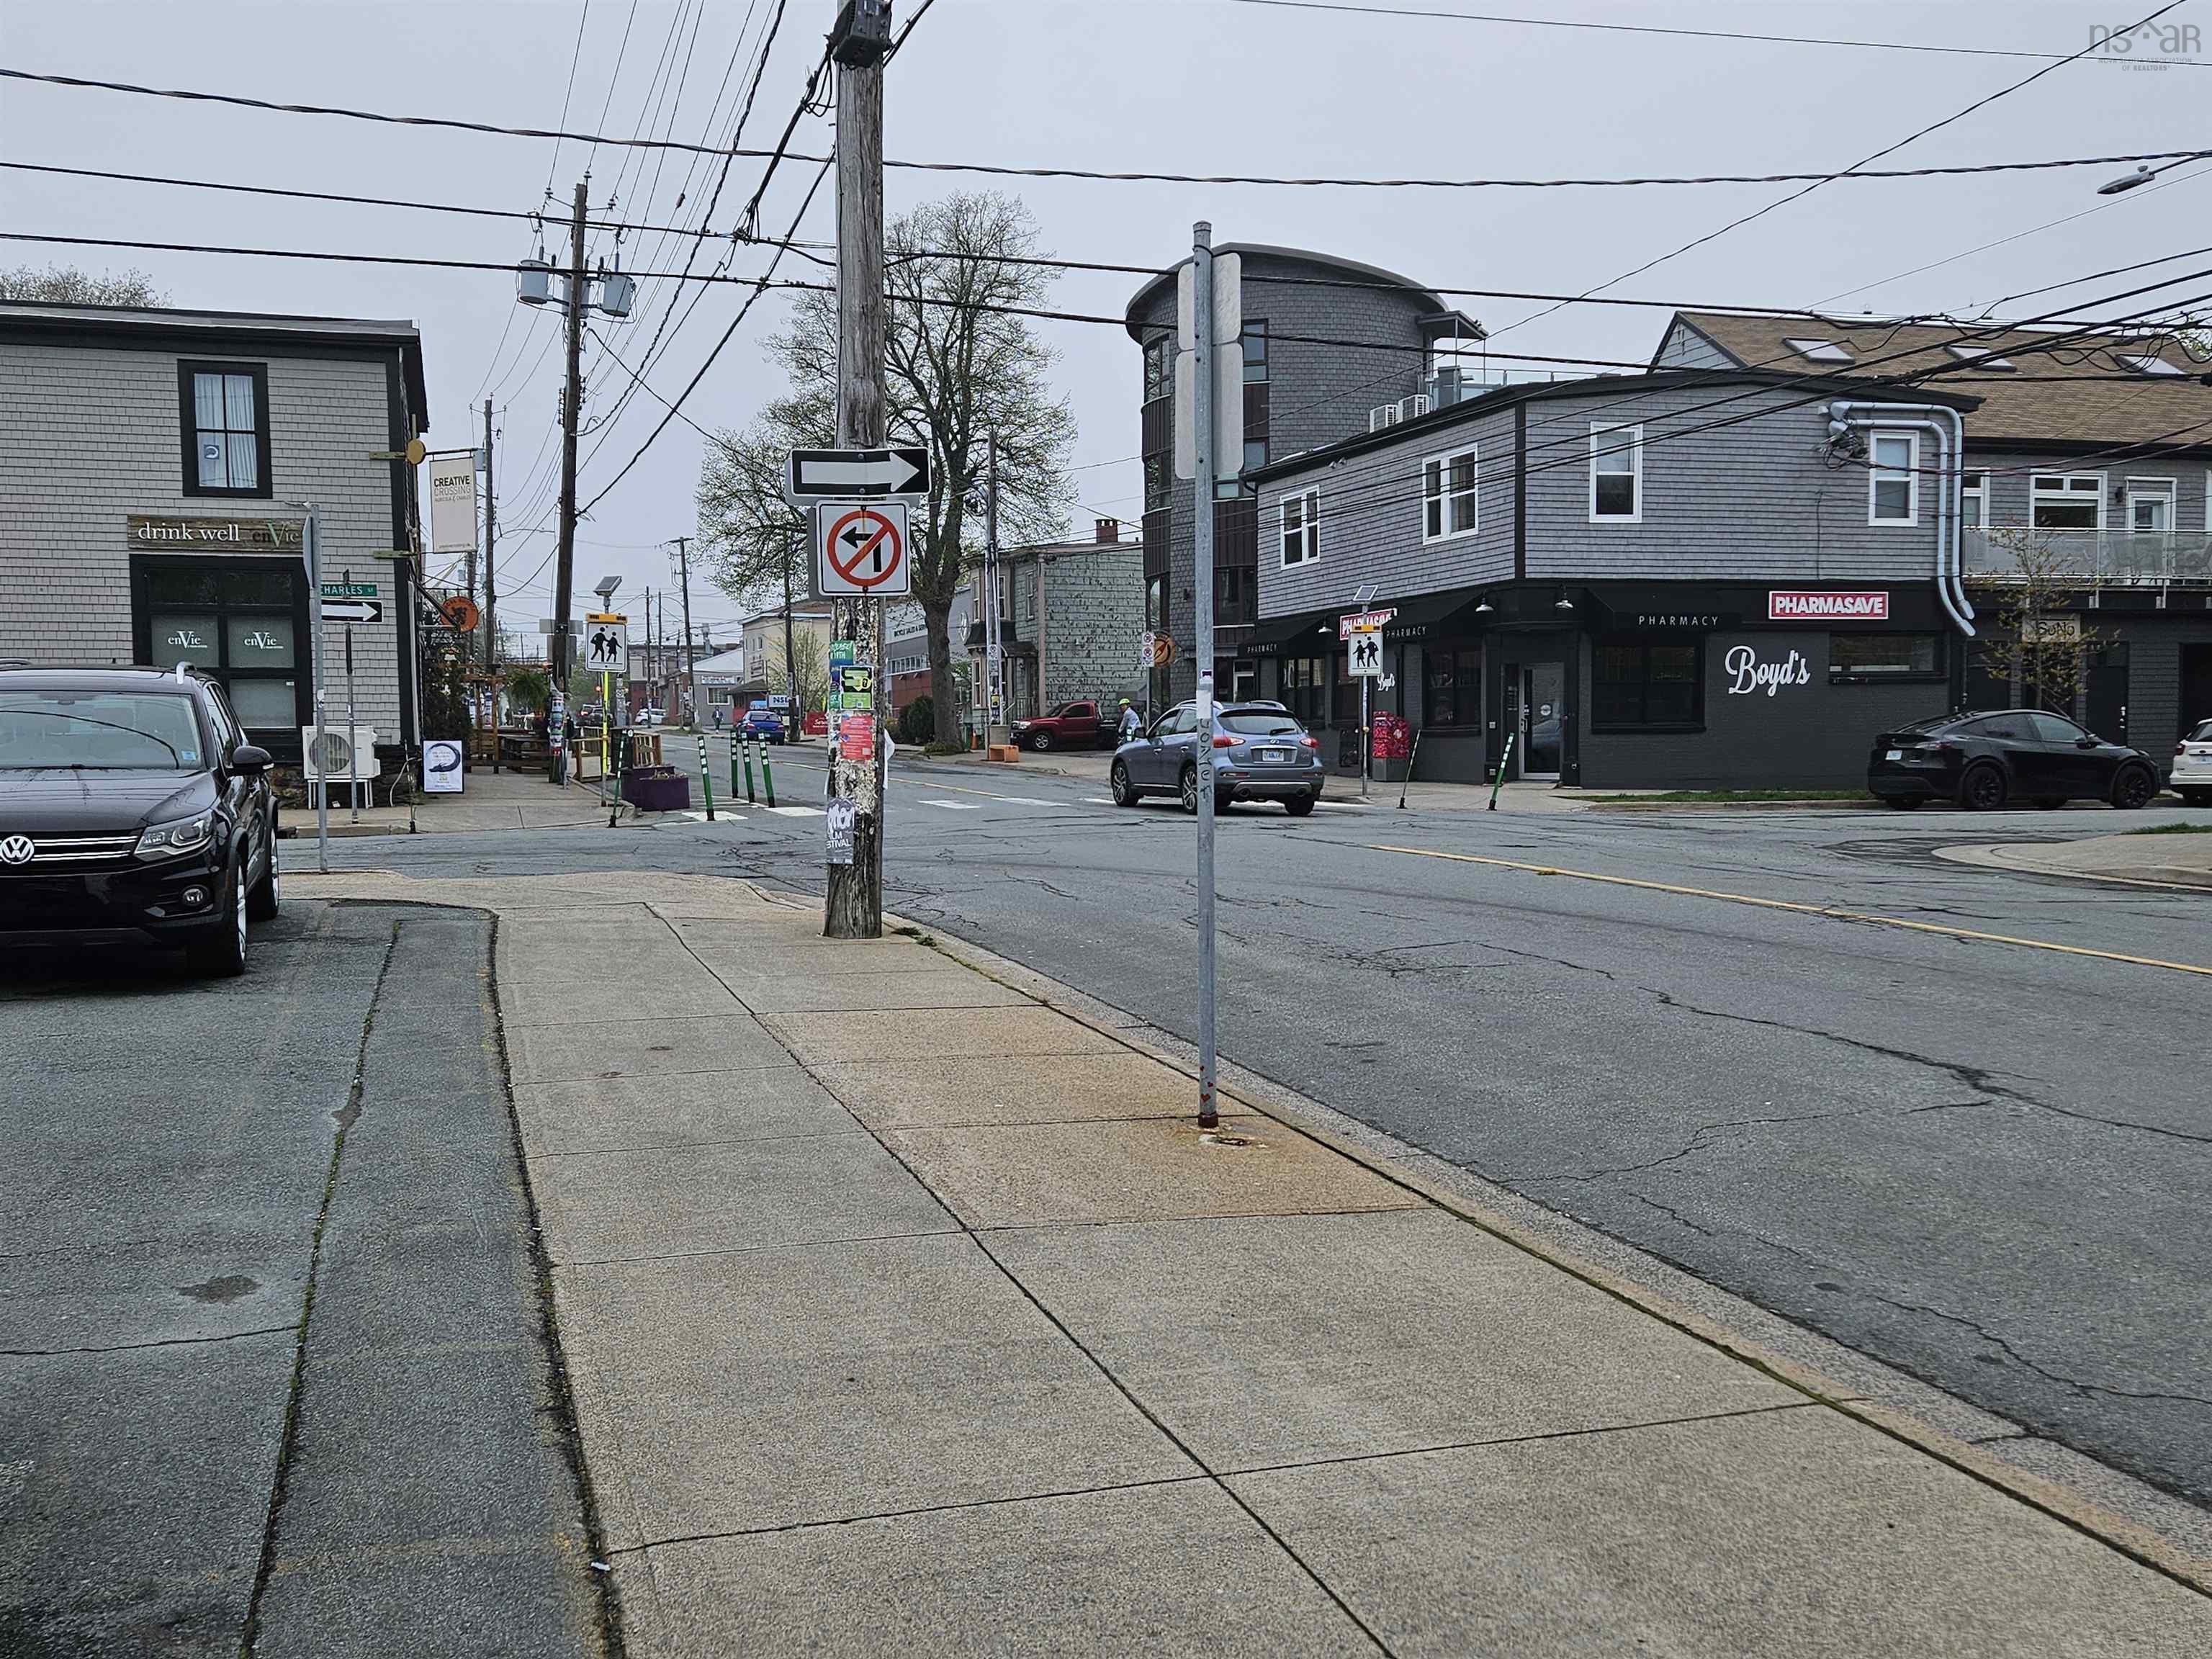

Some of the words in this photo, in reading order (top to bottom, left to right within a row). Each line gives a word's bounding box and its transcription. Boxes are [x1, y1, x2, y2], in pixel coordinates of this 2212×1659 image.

[433, 475, 470, 487] CREATIVE
[433, 485, 472, 497] CROSSING
[138, 522, 193, 540] drink
[199, 523, 240, 541] well
[321, 585, 363, 595] HARLES
[1775, 596, 1884, 614] PHARMASAVE
[1638, 616, 1719, 626] PHARMACY
[1386, 626, 1427, 638] PHARMACY
[167, 630, 202, 649] enVie
[244, 631, 277, 649] enVie
[1247, 643, 1277, 653] PHARMACY
[1724, 644, 1812, 698] Boyd's
